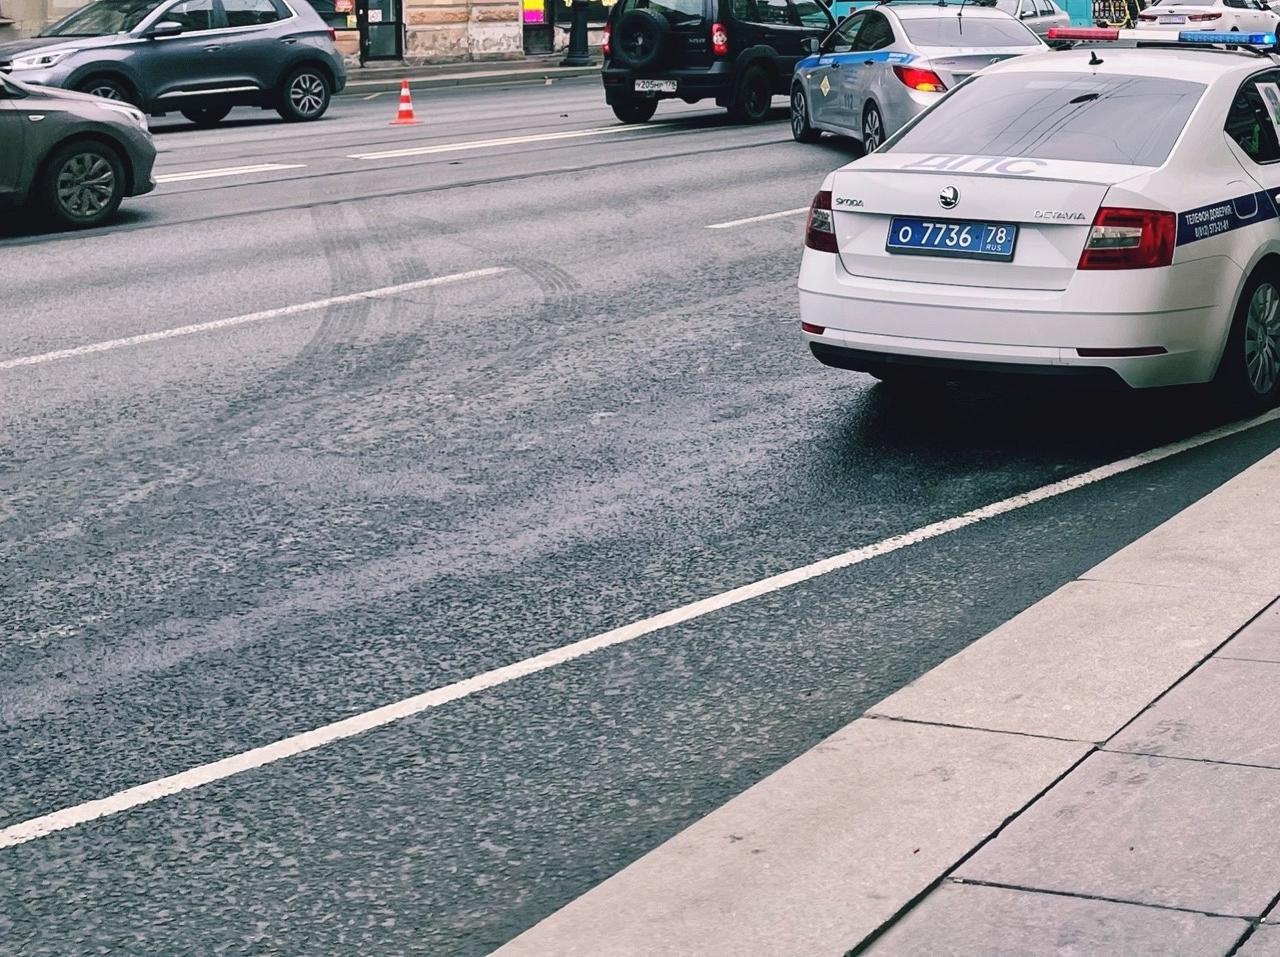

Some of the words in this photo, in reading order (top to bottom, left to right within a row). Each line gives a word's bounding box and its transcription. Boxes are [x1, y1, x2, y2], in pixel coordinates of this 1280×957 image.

[900, 154, 1048, 175] ДПС
[1033, 209, 1086, 221] OCTAVIA
[1185, 210, 1210, 225] ТЕЛЕФОН
[921, 222, 972, 247] 7736
[986, 225, 1007, 244] 78
